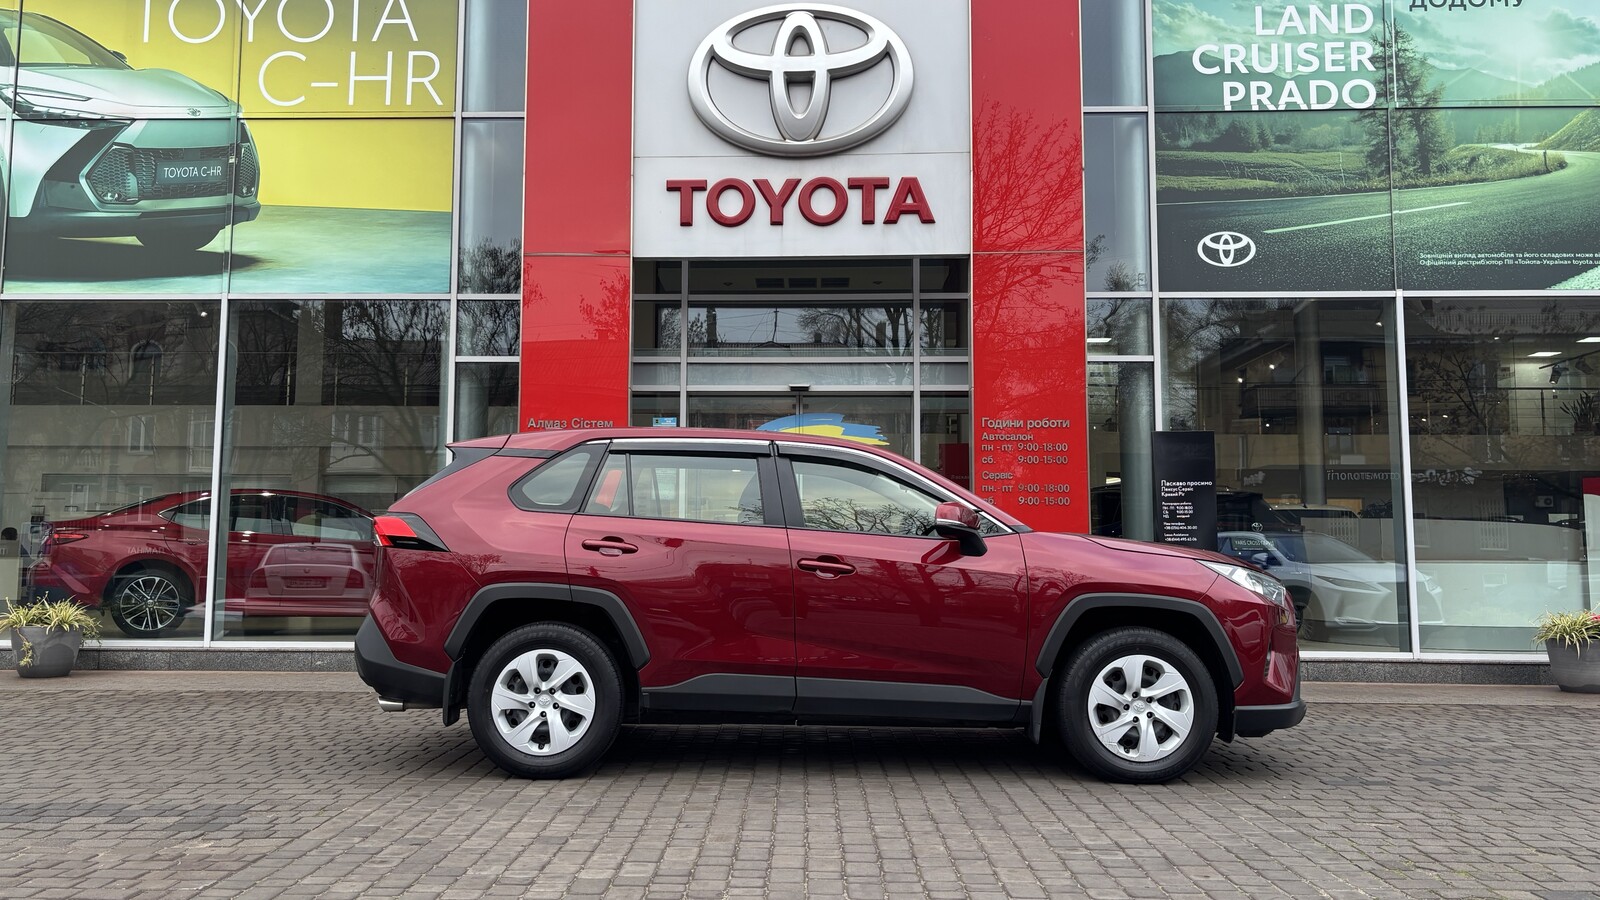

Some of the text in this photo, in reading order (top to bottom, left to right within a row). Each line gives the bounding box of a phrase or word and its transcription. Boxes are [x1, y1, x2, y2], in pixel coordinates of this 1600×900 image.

[143, 0, 419, 44] TOYOTA
[1254, 4, 1374, 36] LAND
[1192, 41, 1377, 75] CRUISER
[258, 51, 444, 107] C-HR
[1223, 79, 1377, 111] PRADO
[164, 166, 222, 178] TOYOTA C-HR
[666, 176, 936, 227] TOYOTA
[527, 417, 613, 429] Алмаз Сістем
[981, 417, 1070, 430] Години роботи
[981, 432, 1034, 441] Автосалон
[1018, 443, 1068, 451] 9:00-18:00
[981, 455, 1068, 464] сб. 9:00-15:00
[981, 471, 1014, 481] Сервіс
[1018, 484, 1070, 493] 9:00-18:00
[1018, 496, 1070, 505] 9:00-15:00
